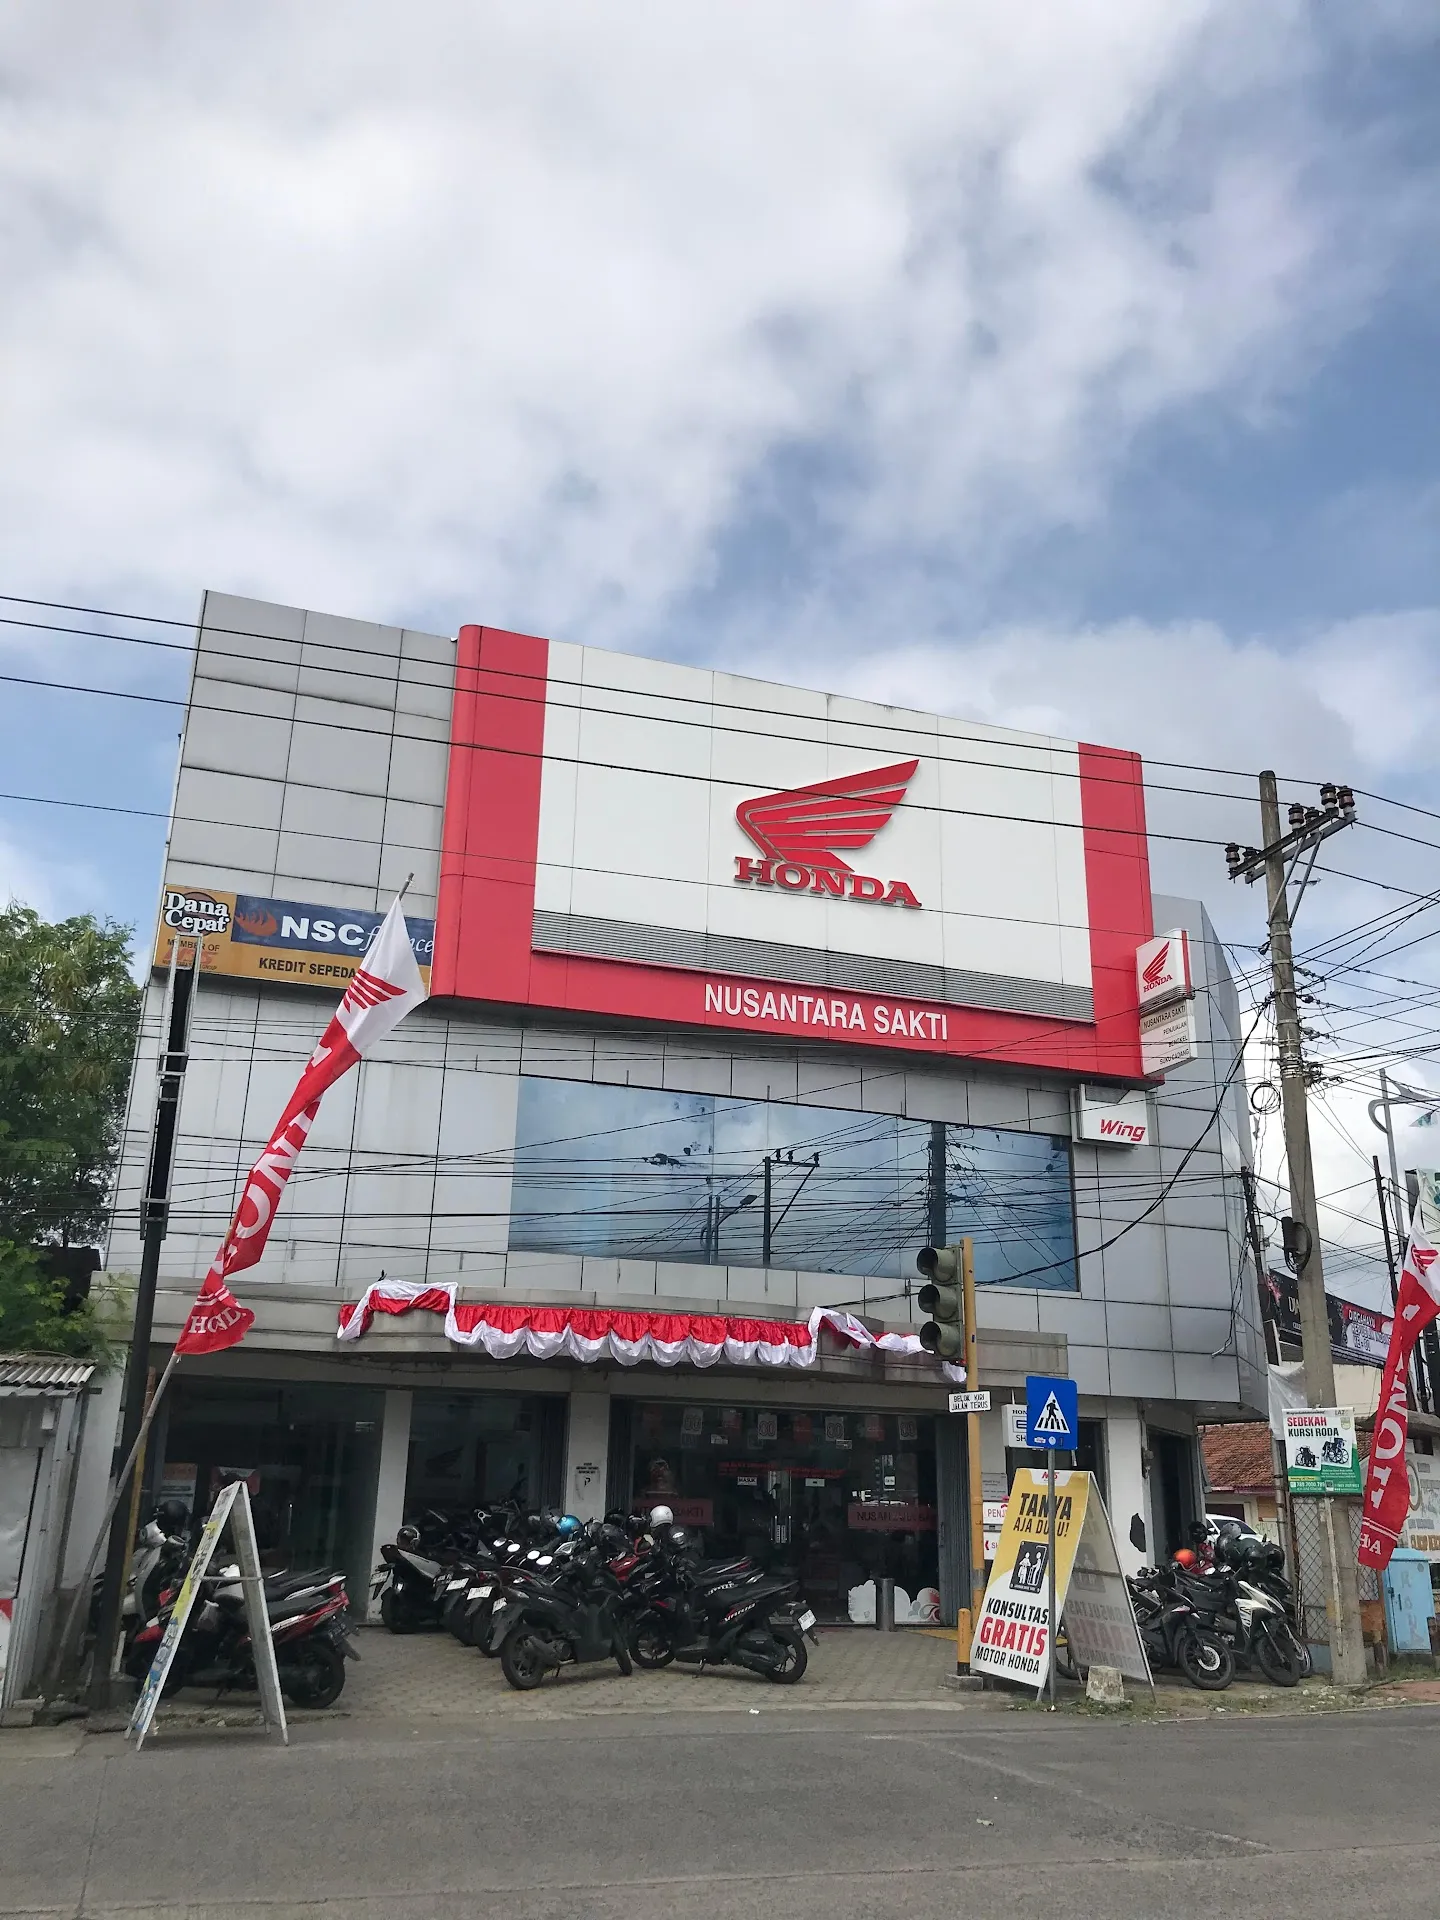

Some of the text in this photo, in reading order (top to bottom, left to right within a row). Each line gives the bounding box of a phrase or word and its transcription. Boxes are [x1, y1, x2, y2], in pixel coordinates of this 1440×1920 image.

[734, 856, 922, 909] HONDA
[165, 892, 229, 917] Dana
[165, 909, 226, 935] Cepat
[280, 915, 365, 946] NSC
[208, 943, 220, 952] OF
[259, 957, 356, 979] KREDIT SEPEDA
[1143, 973, 1173, 993] HONDA
[705, 983, 948, 1041] NUSANTARA SAKTI
[1100, 1118, 1146, 1142] Wing
[1287, 1416, 1327, 1427] SEDEKAH
[1288, 1427, 1339, 1437] KURSI RODA
[1013, 1517, 1070, 1537] AJA DUU!
[986, 1597, 1050, 1625] KONSULTAS
[980, 1616, 1048, 1656] GRATIS
[975, 1646, 1040, 1674] MOTOR HONDA
